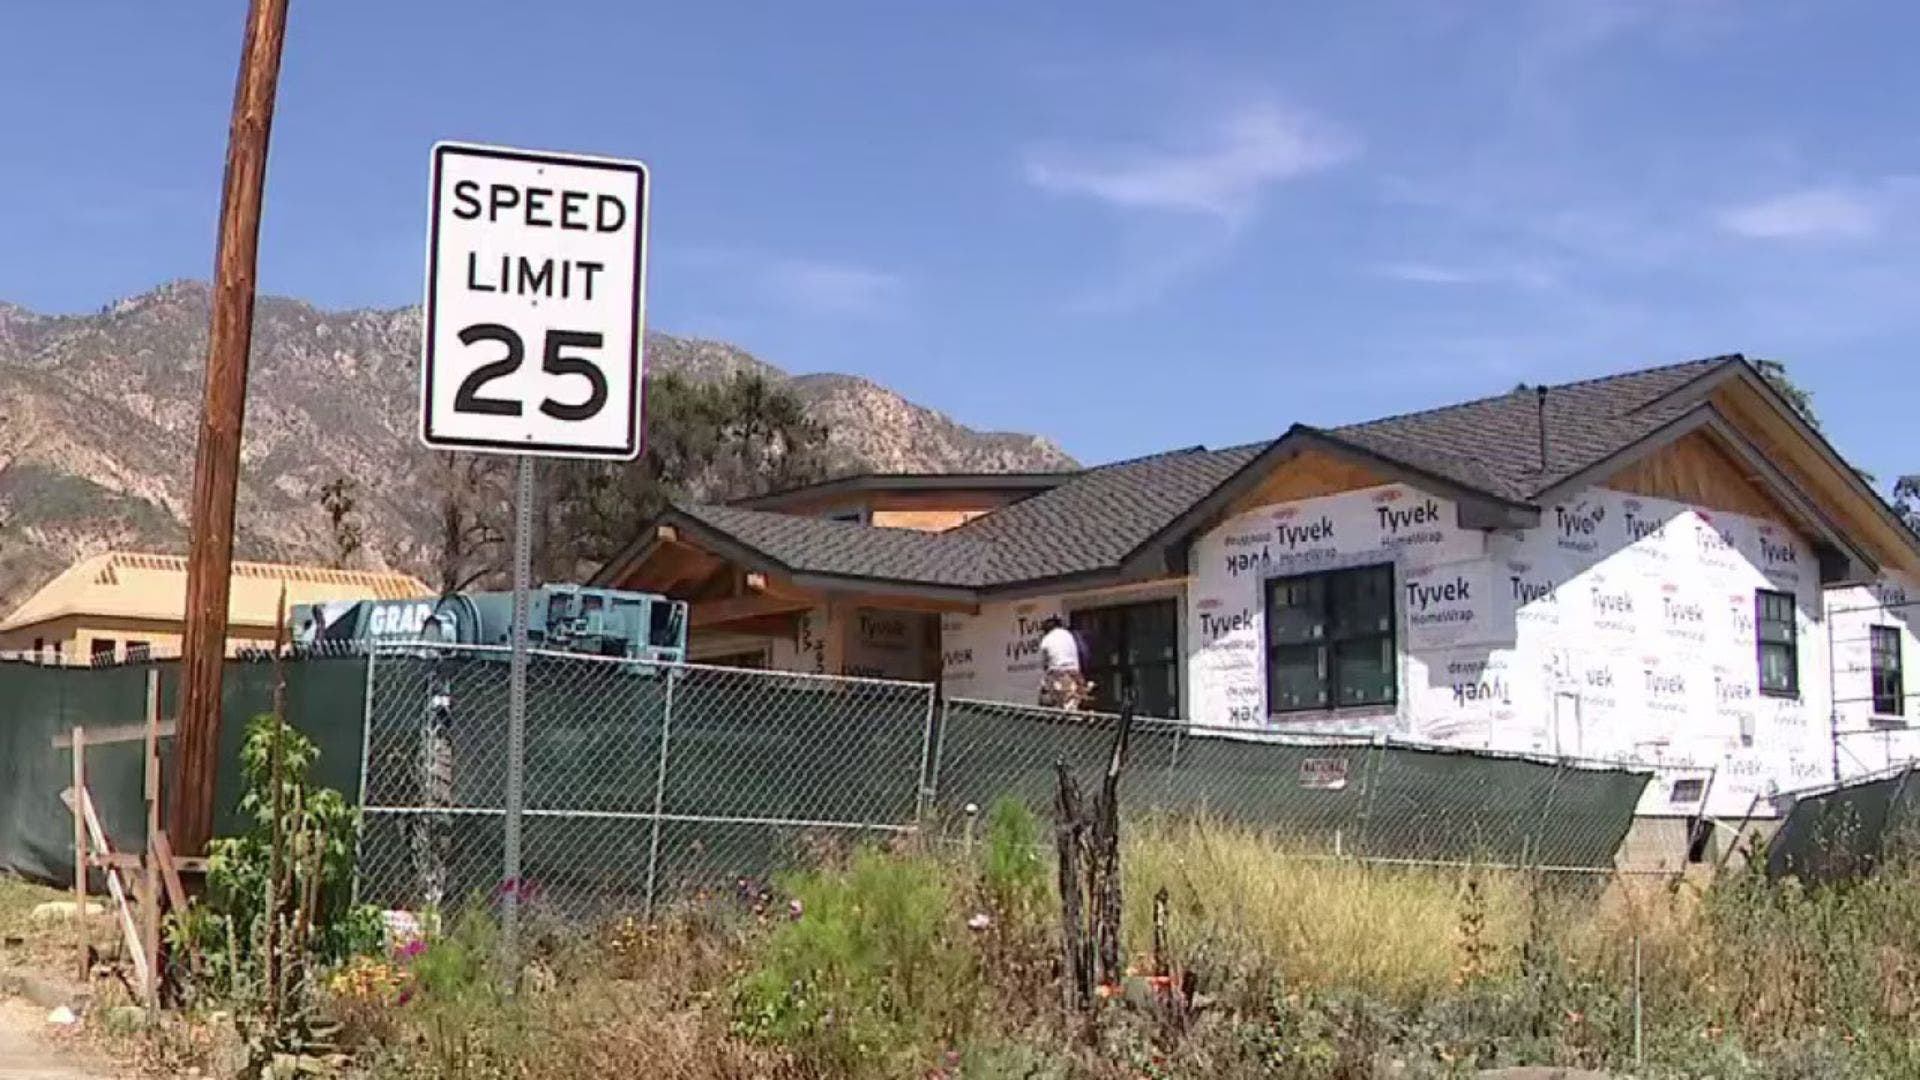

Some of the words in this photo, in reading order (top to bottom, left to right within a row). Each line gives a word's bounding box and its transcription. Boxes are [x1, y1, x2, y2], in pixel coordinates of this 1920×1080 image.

[453, 180, 626, 233] SPEED
[468, 251, 604, 300] LIMIT
[453, 323, 608, 421] 25
[1276, 515, 1334, 550] Tyvek
[1376, 500, 1438, 533] Tyvek
[1625, 513, 1665, 542] Tyvek
[1759, 537, 1798, 564] Tyvek
[1406, 576, 1470, 610] Tyvek
[1511, 576, 1557, 605] Tyvek
[1591, 586, 1634, 616] Tyvek
[1200, 607, 1253, 640] Tyvek
[1663, 597, 1704, 625] Tyvek
[1454, 675, 1512, 708] Tyvek
[1644, 669, 1685, 698] Tyvek
[1714, 676, 1752, 704] Tyvek
